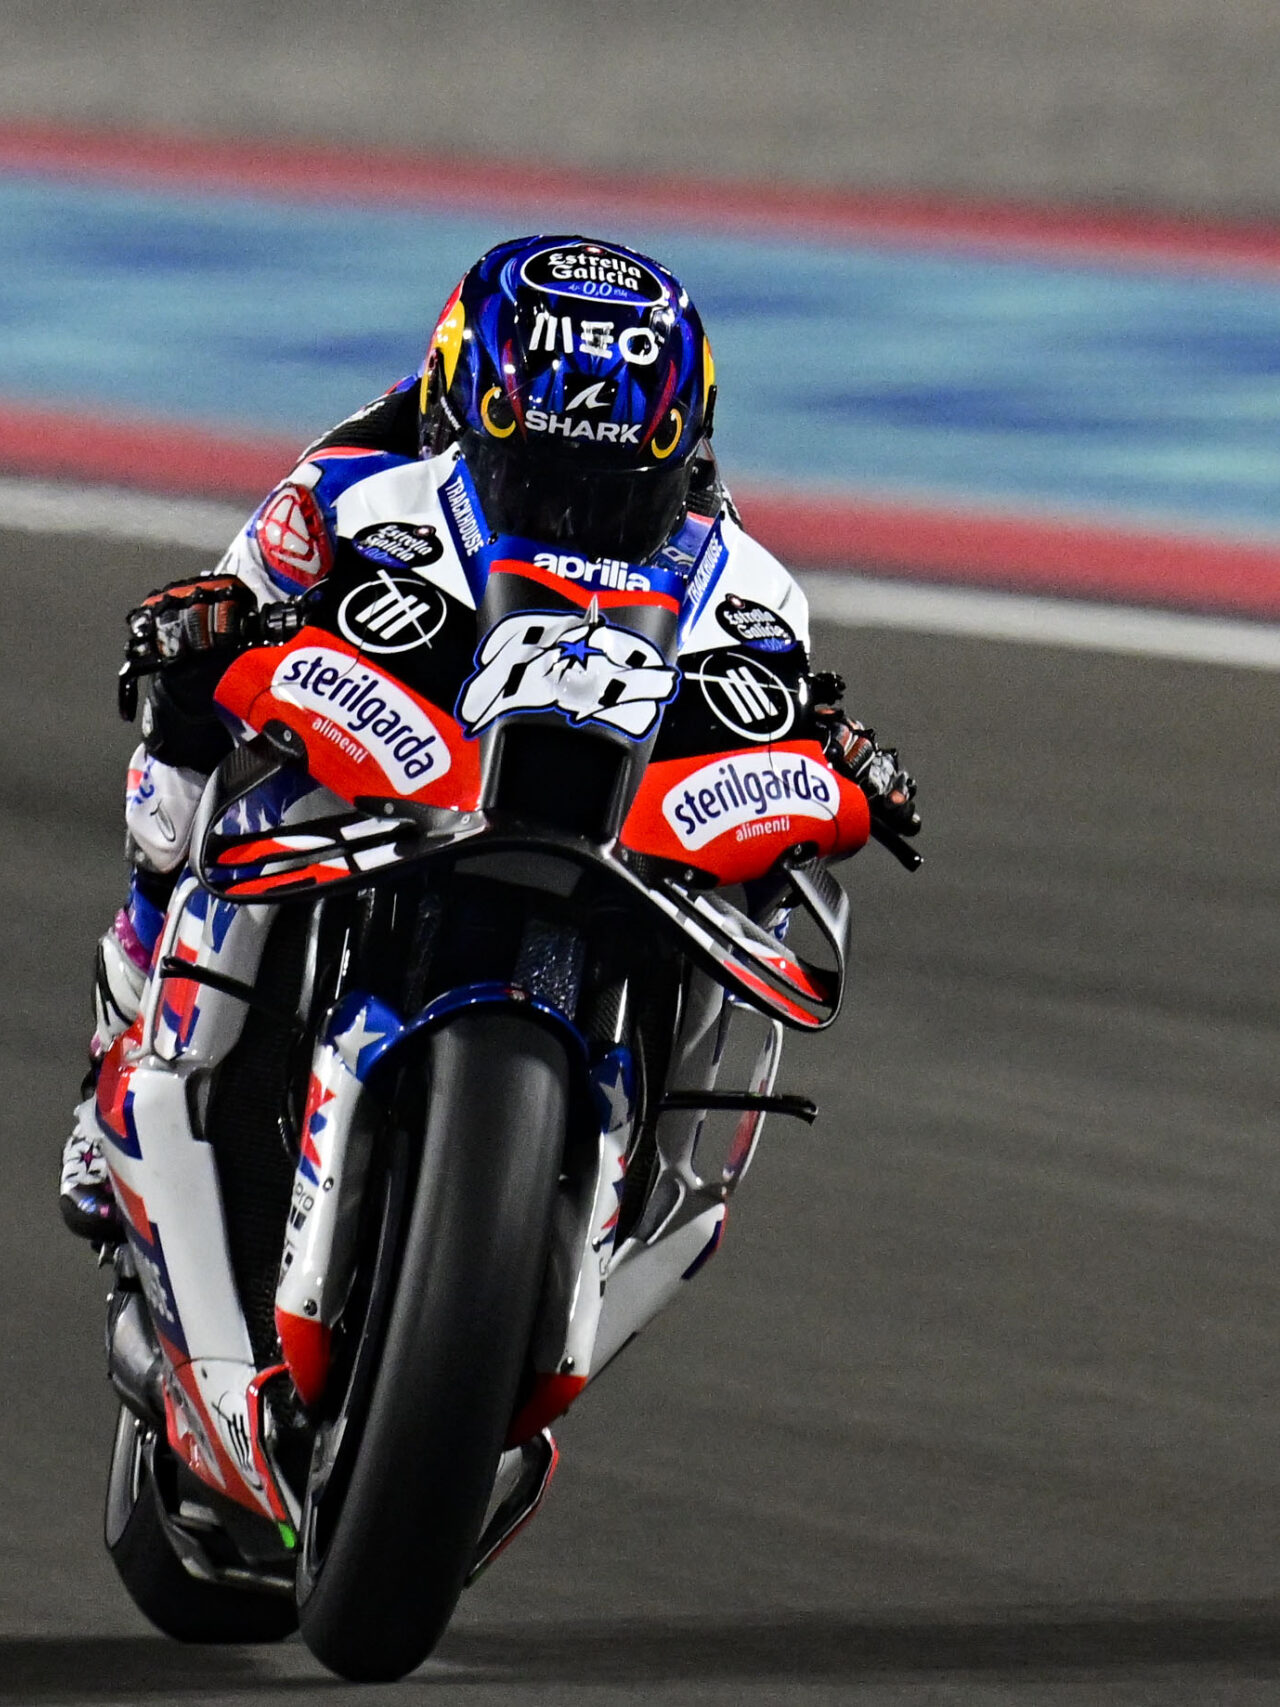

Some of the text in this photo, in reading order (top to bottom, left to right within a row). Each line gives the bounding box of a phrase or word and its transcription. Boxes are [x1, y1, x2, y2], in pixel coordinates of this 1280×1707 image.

[548, 252, 642, 279] Estrella
[552, 264, 640, 291] Galicia
[524, 409, 643, 444] SHARK
[445, 475, 484, 557] TRACKHOUSE
[533, 552, 651, 593] aprilia
[283, 656, 434, 780] sterilgarda
[311, 717, 370, 765] alimenti
[674, 758, 831, 836] sterilgarda
[734, 816, 791, 843] alimenti
